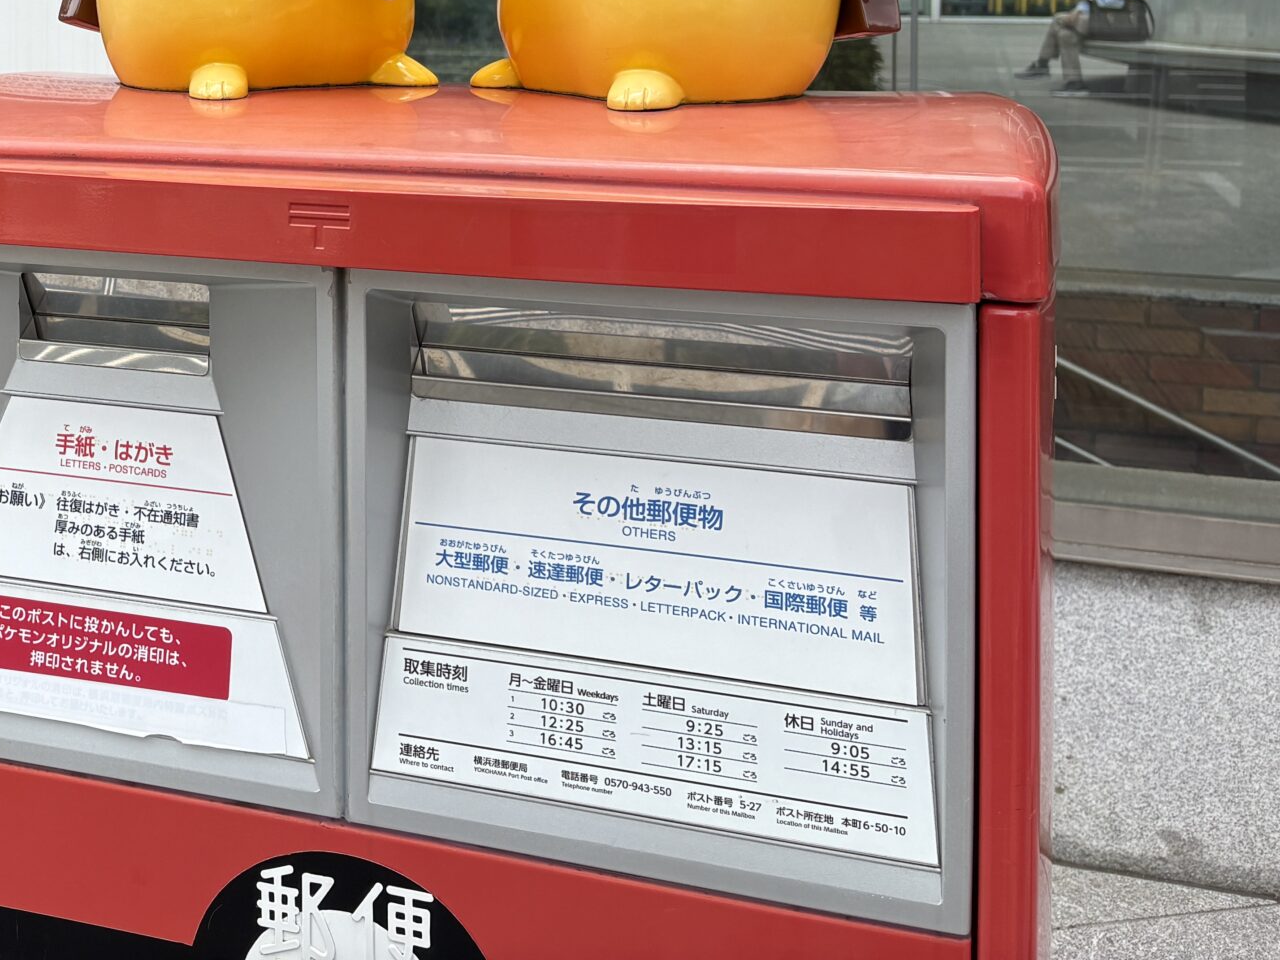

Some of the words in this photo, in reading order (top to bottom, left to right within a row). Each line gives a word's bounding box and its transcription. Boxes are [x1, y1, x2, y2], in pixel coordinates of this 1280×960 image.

[55, 432, 174, 466] 手紙・はがき
[630, 484, 639, 493] た
[654, 486, 711, 500] ゆうびんぶつ
[56, 497, 200, 529] 往復はがき・不在通知書
[572, 491, 724, 531] その他郵便物
[54, 519, 145, 545] 厚みのある手紙
[622, 525, 676, 542] OTHERS
[439, 538, 507, 554] おおがたゆうびん
[530, 548, 601, 565] そくたつゆうびん
[53, 542, 216, 578] は、右側にお入れください。
[767, 577, 846, 596] こくさいゆうびん
[857, 589, 877, 601] など
[426, 573, 559, 600] NONSTANDARD-SIZED
[569, 592, 629, 609] EXPRESS
[640, 601, 727, 623] LETTERPACK
[737, 613, 848, 640] INTERNATIONAL
[851, 629, 885, 644] MAIL
[859, 604, 878, 623] 等
[29, 650, 142, 682] 押印されません。
[403, 657, 469, 683] 取集時刻
[403, 676, 445, 691] Collection
[446, 681, 469, 693] times
[577, 688, 619, 702] Weekdays
[541, 697, 585, 715] 10:30
[602, 712, 617, 721] ごろ
[642, 692, 686, 712] 土曜日
[691, 704, 729, 719] Saturday
[510, 712, 515, 720] 2
[541, 714, 584, 733] 12:25
[602, 729, 616, 738] ごろ
[686, 719, 724, 737] 9:25
[742, 733, 757, 743] ごろ
[783, 712, 814, 732] 休日
[820, 717, 854, 732] Sunday
[855, 723, 874, 733] and
[820, 726, 860, 740] Holidays
[399, 742, 440, 761] 連絡先
[509, 729, 514, 737] 3
[540, 732, 584, 750] 16:45
[601, 747, 616, 756] ごろ
[677, 736, 722, 755] 13:15
[742, 752, 757, 761] ごろ
[830, 742, 870, 760] 9:05
[890, 756, 907, 766] ごろ
[399, 758, 420, 767] Where
[430, 763, 455, 772] contact
[473, 755, 528, 773] 横浜港郵便局
[473, 767, 507, 777] YOKOHAMA
[677, 754, 722, 773] 17:15
[742, 770, 757, 780] ごろ
[822, 759, 870, 778] 14:55
[890, 775, 907, 785] ごろ
[561, 769, 599, 785] 電話番号
[604, 777, 673, 797] 0570-943-550
[561, 781, 590, 792] Telephone
[591, 787, 613, 795] number
[686, 791, 734, 808] ポスト番号
[739, 799, 762, 812] 5-27
[687, 803, 706, 813] Number
[775, 806, 834, 825] ポスト所在地
[841, 817, 907, 837] 本町6-50-10
[776, 818, 801, 828] Location
[256, 864, 435, 960] 郵便
